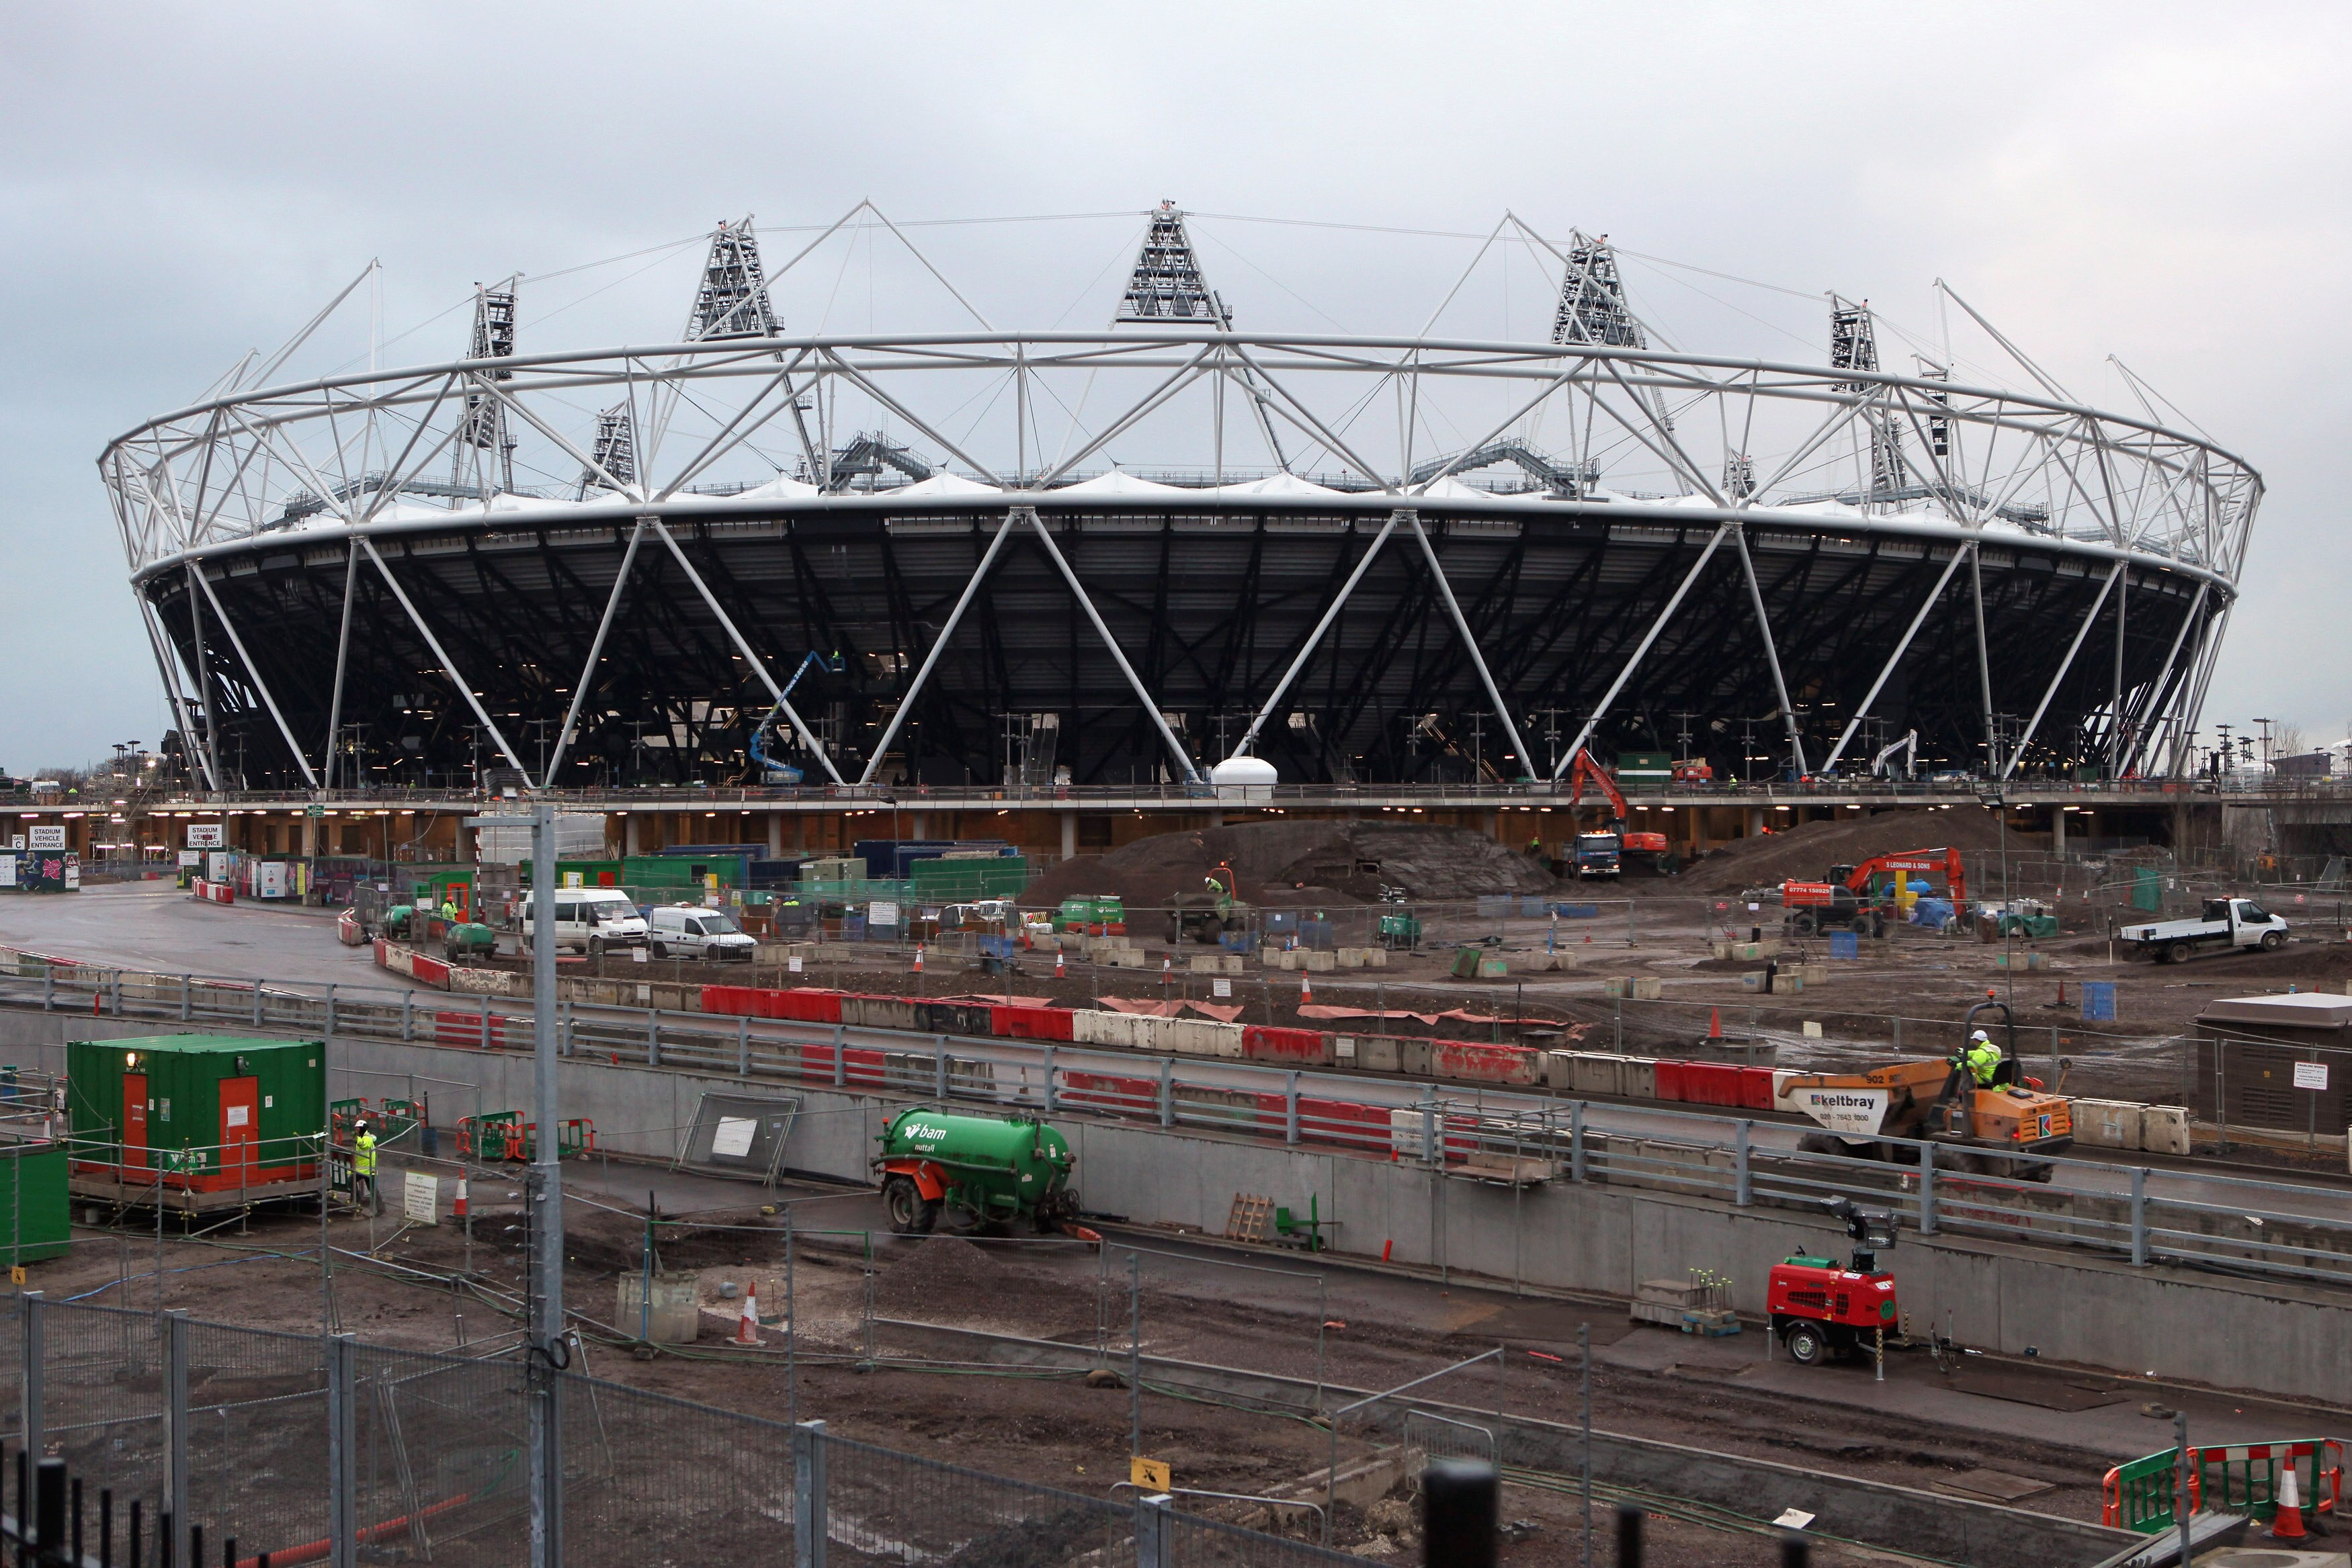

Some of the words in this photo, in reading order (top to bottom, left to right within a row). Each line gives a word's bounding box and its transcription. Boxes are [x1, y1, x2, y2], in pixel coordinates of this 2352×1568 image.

[1866, 1076, 1884, 1084] 902
[1821, 1095, 1874, 1110] keltbray
[1853, 1113, 1870, 1121] 1000
[919, 1124, 947, 1140] bam
[915, 1144, 935, 1152] nuttall
